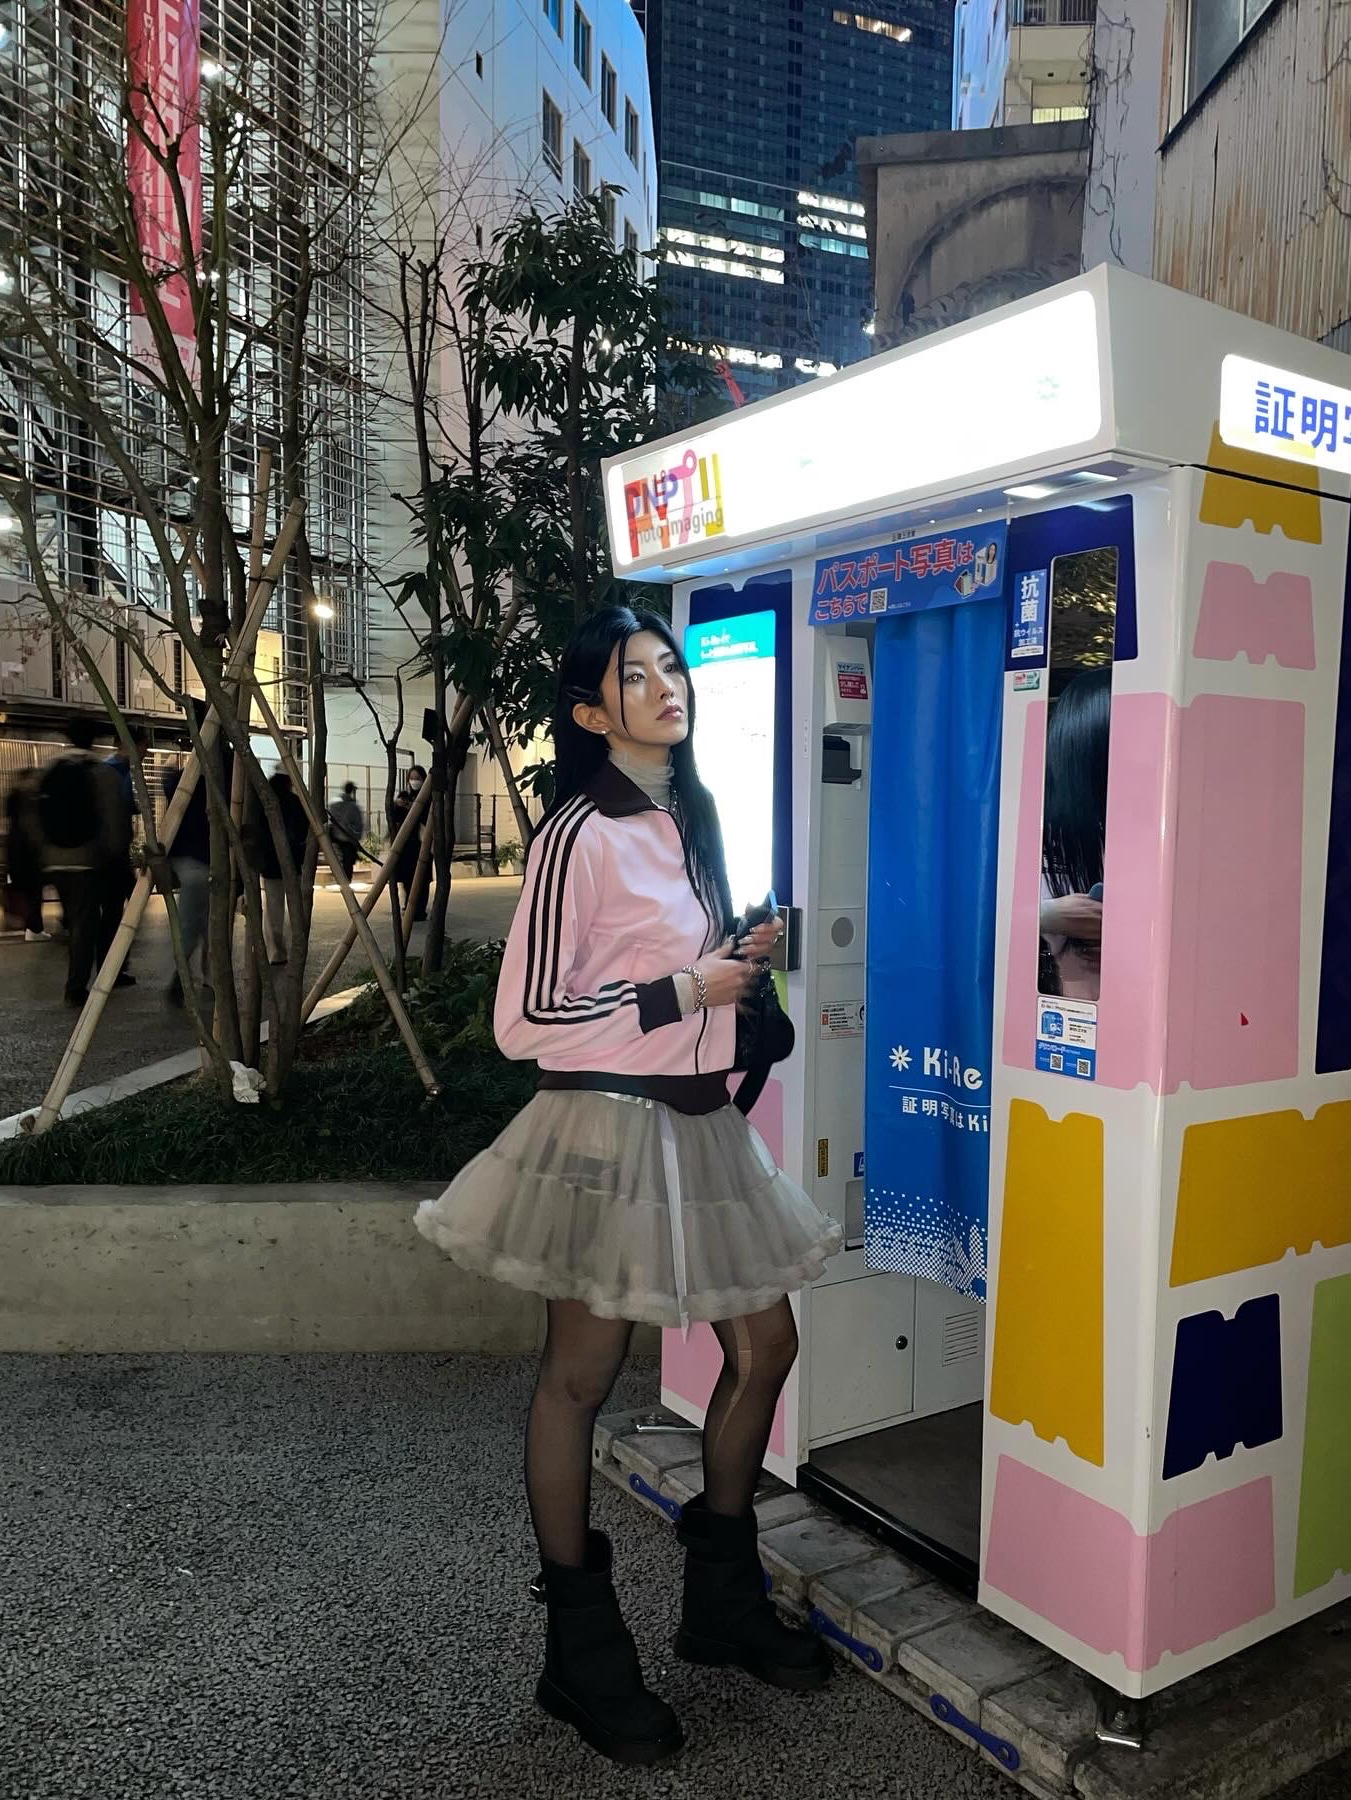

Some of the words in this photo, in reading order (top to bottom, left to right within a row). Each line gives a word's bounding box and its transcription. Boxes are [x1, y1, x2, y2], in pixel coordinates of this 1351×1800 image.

[817, 537, 975, 595] パスポート写真は
[815, 592, 868, 621] こちらで
[1020, 575, 1040, 623] 抗菌
